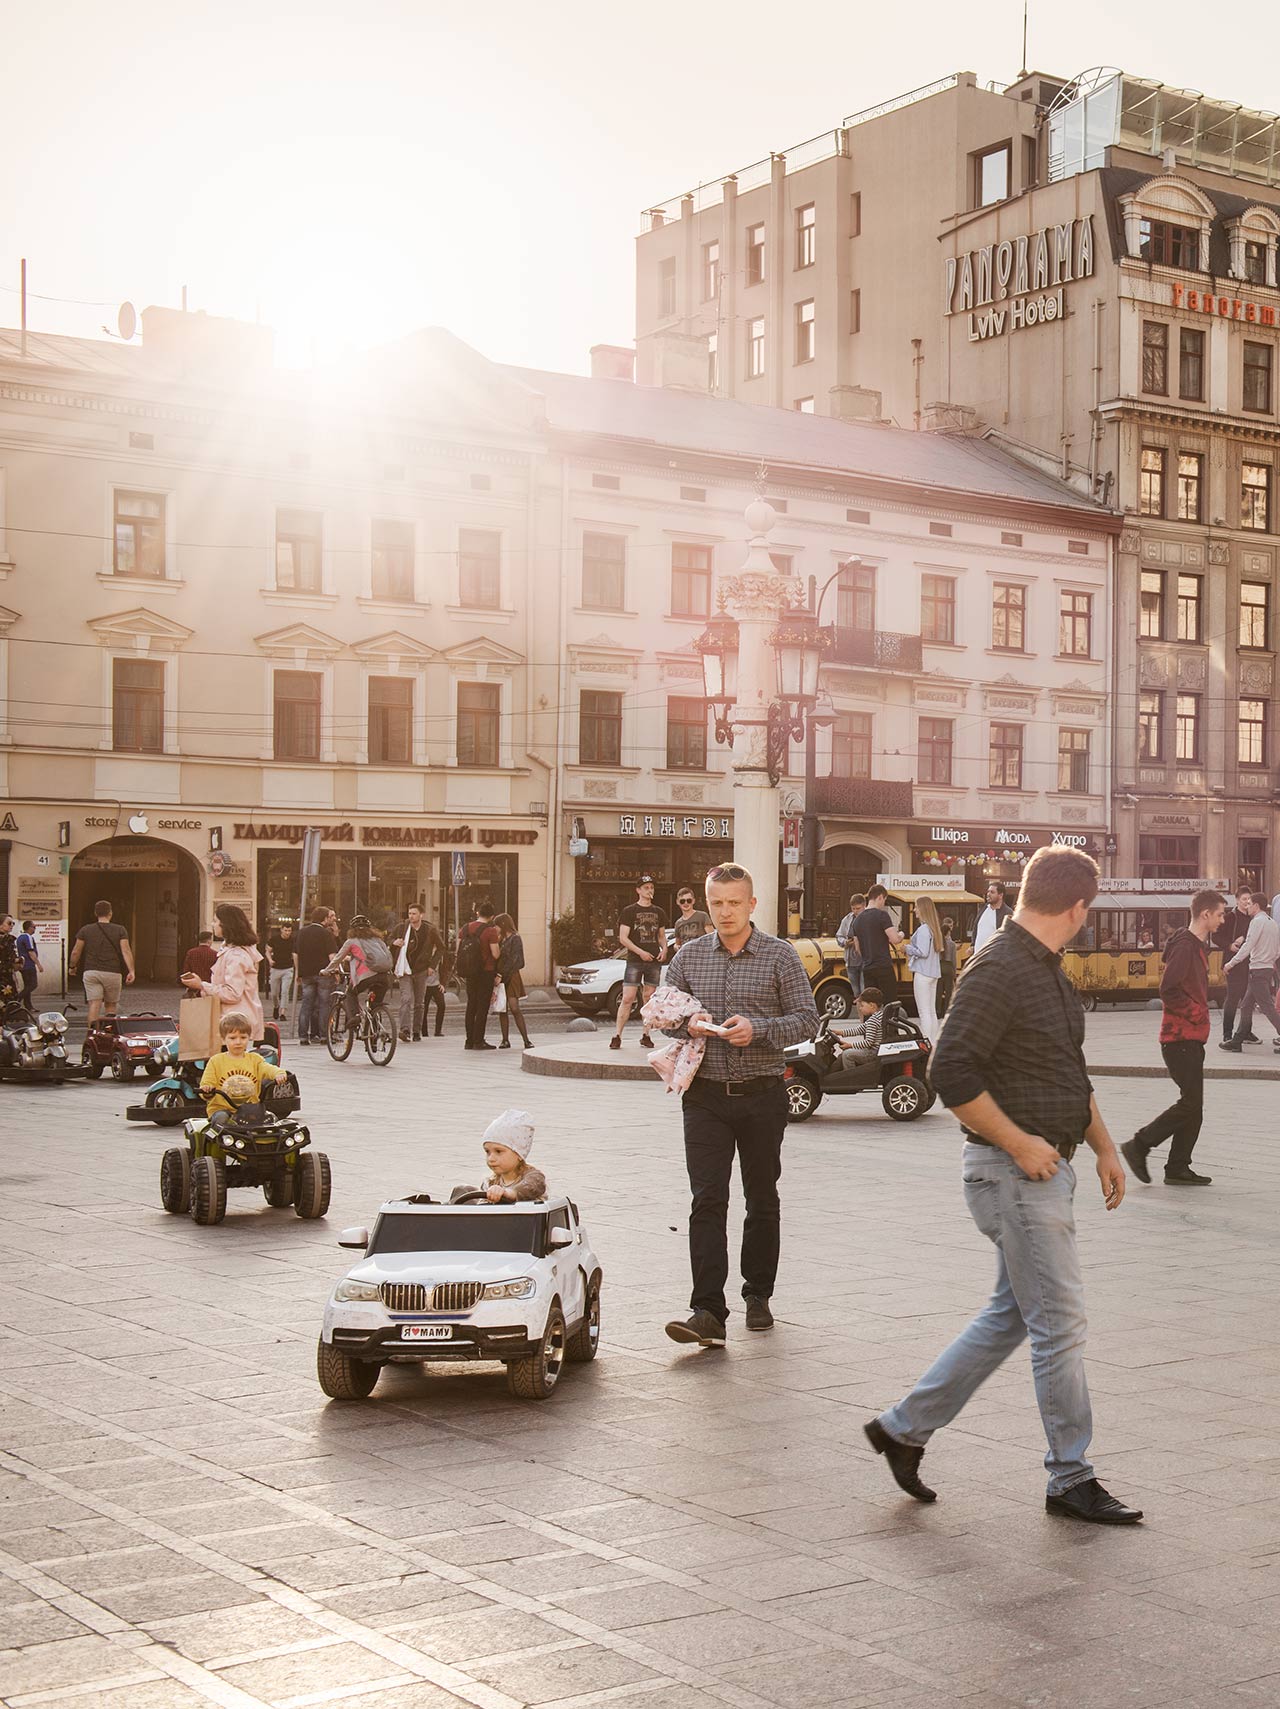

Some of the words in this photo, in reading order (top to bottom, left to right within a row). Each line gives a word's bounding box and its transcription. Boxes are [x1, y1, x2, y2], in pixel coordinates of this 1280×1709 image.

[944, 214, 1093, 316] PANORAMA
[968, 308, 1005, 342] Lviv
[1011, 288, 1063, 329] Hotel
[85, 816, 119, 827] store
[158, 819, 202, 830] service
[620, 814, 730, 838] ПІНГВІ
[233, 823, 354, 844] ГАЛИЦИЙ
[477, 829, 539, 848] ЦЕНТР
[931, 827, 969, 844] Шкіра
[38, 855, 49, 865] 41
[892, 878, 920, 890] Площа
[921, 878, 945, 888] Ринок
[1113, 881, 1130, 889] тури
[1153, 879, 1191, 889] Sightseeing
[404, 1328, 410, 1336] Я
[421, 1328, 449, 1336] МАМУ
